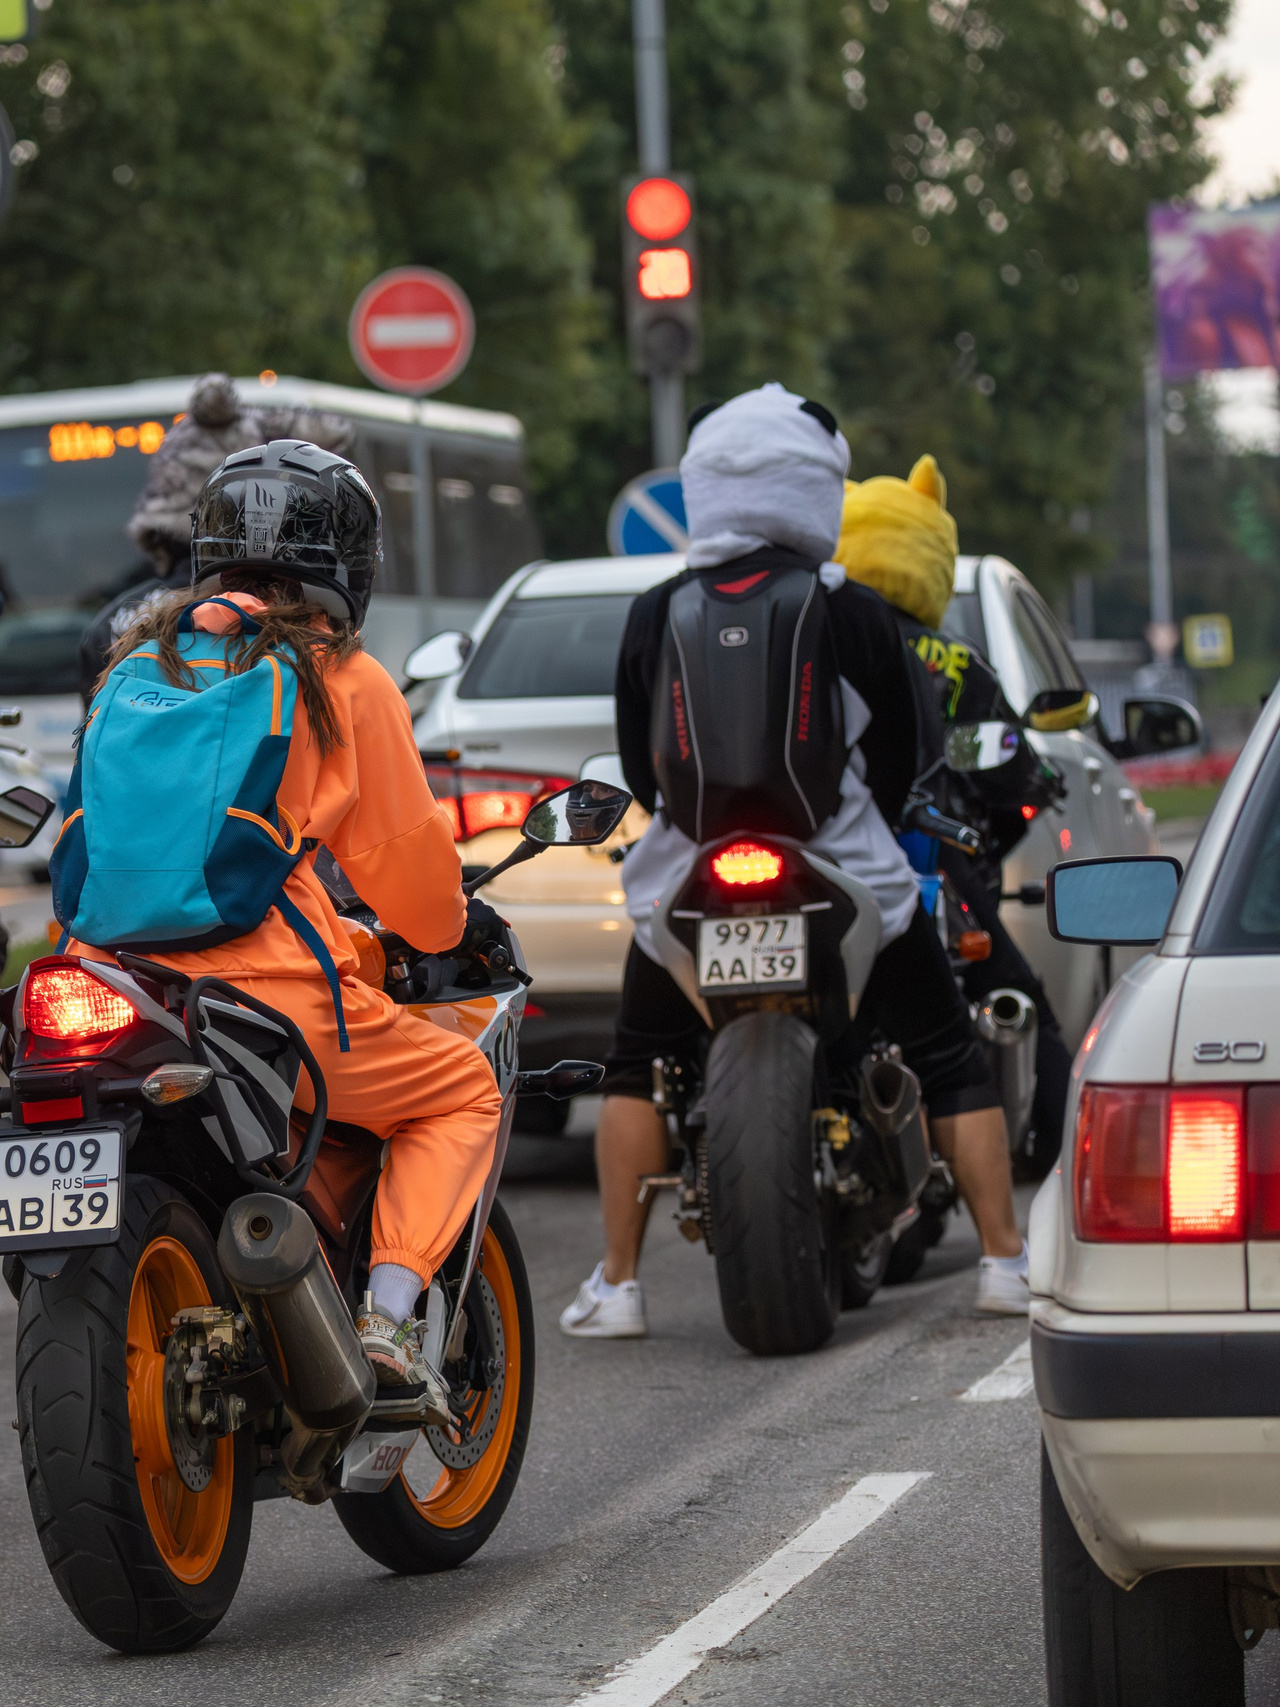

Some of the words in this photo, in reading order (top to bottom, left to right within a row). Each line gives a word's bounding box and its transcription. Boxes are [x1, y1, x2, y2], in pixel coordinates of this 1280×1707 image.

[715, 920, 788, 946] 9977
[706, 957, 748, 981] AA
[761, 955, 797, 977] 39
[1193, 1041, 1265, 1063] 80
[5, 1138, 101, 1178] 0609
[51, 1177, 83, 1190] RUS
[62, 1191, 109, 1227] 39
